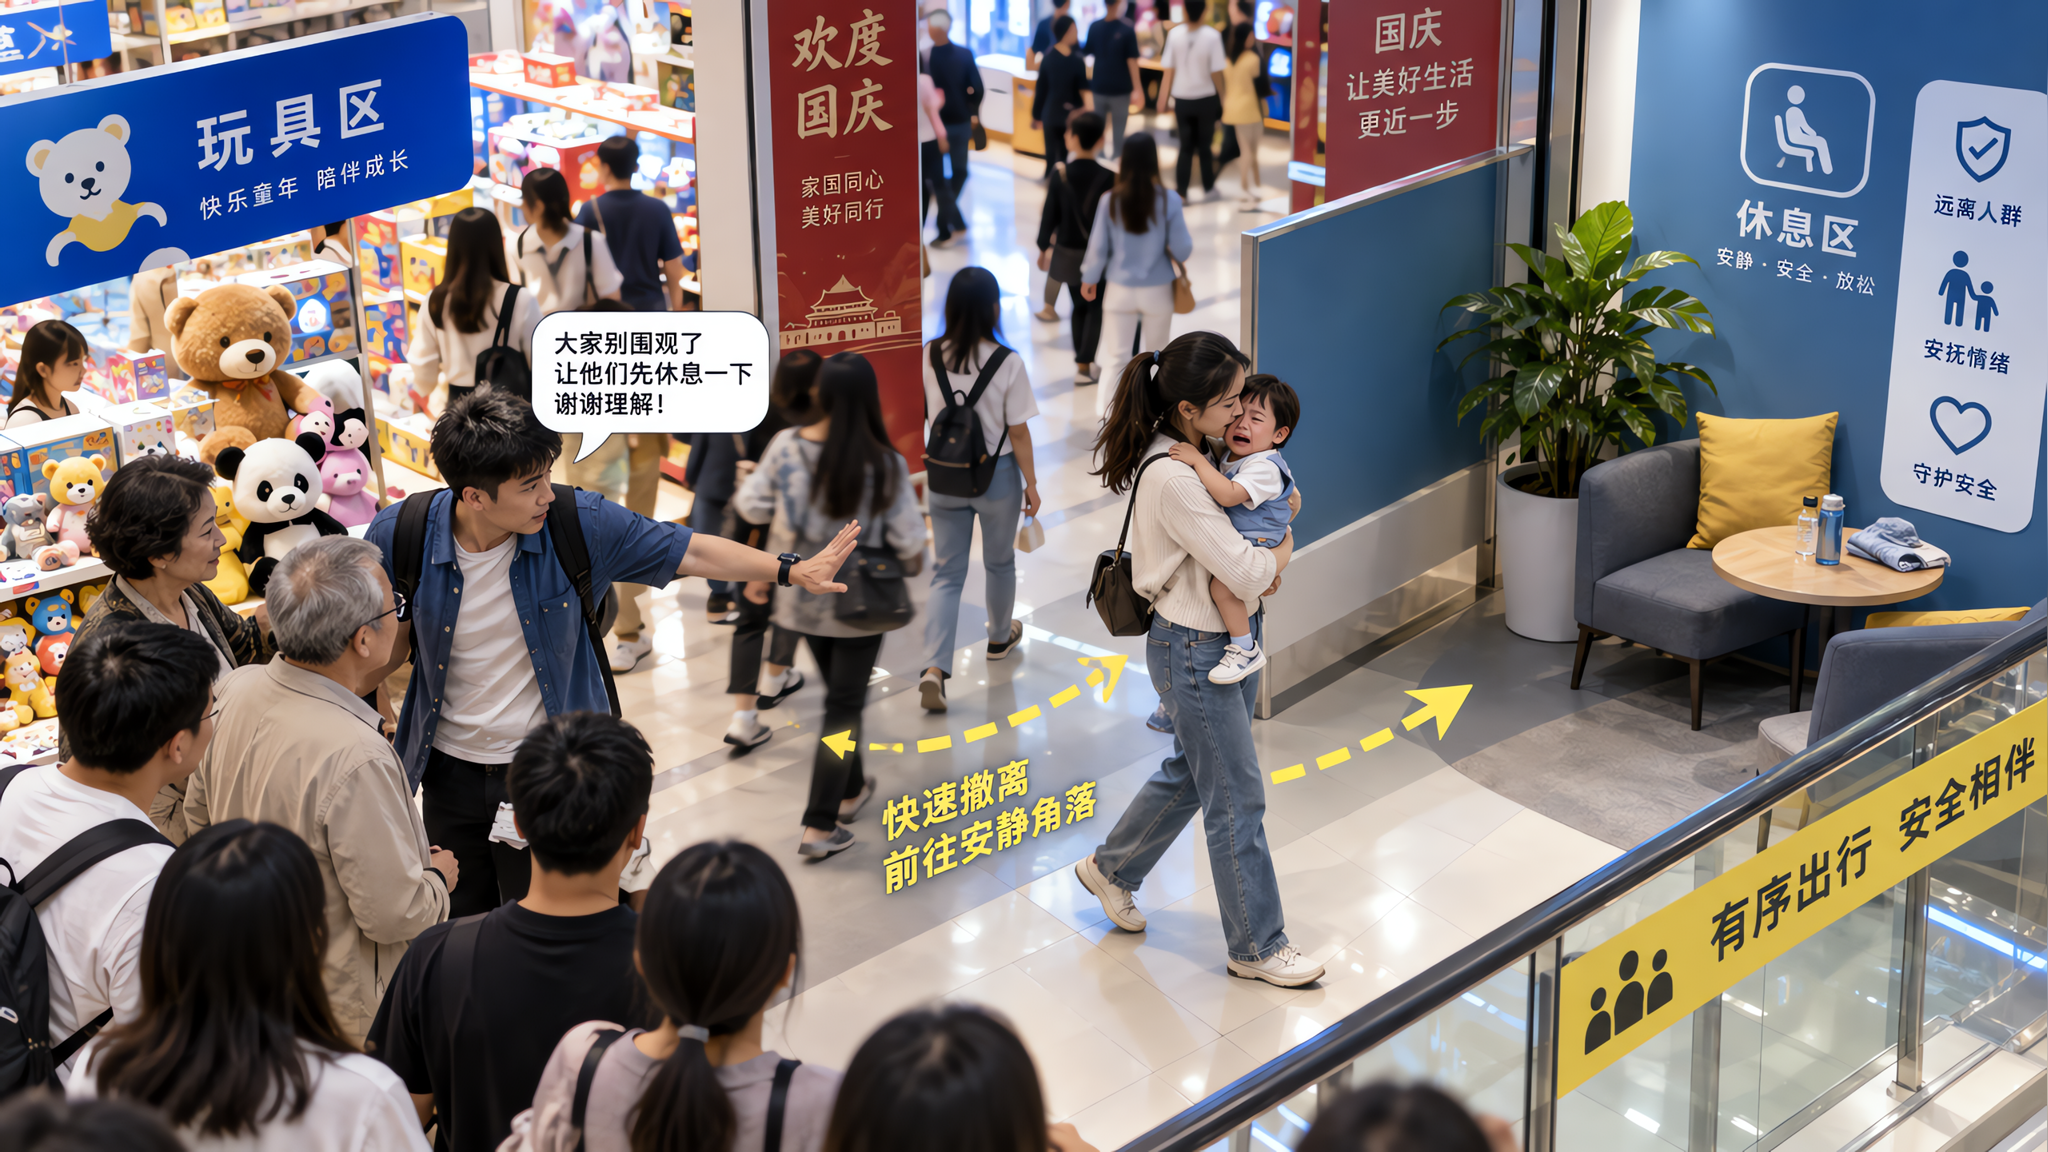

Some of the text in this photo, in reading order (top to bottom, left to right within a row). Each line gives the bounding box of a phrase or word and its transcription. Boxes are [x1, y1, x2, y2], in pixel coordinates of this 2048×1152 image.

[791, 8, 893, 72] 欢度
[1375, 7, 1442, 54] 国庆
[1346, 57, 1474, 101] 让美好生活
[196, 78, 385, 172] 玩具区
[797, 77, 893, 140] 国庆
[1358, 99, 1459, 139] 更近一步
[199, 148, 409, 221] 快乐童年 陪伴成长
[801, 168, 884, 198] 家国同心
[801, 198, 884, 229] 美好同行
[1736, 198, 1859, 258] 休息区
[1933, 193, 2023, 228] 远离人群
[1913, 462, 1998, 502] 守护安全
[1710, 736, 2035, 962] 有序出行 安全相伴
